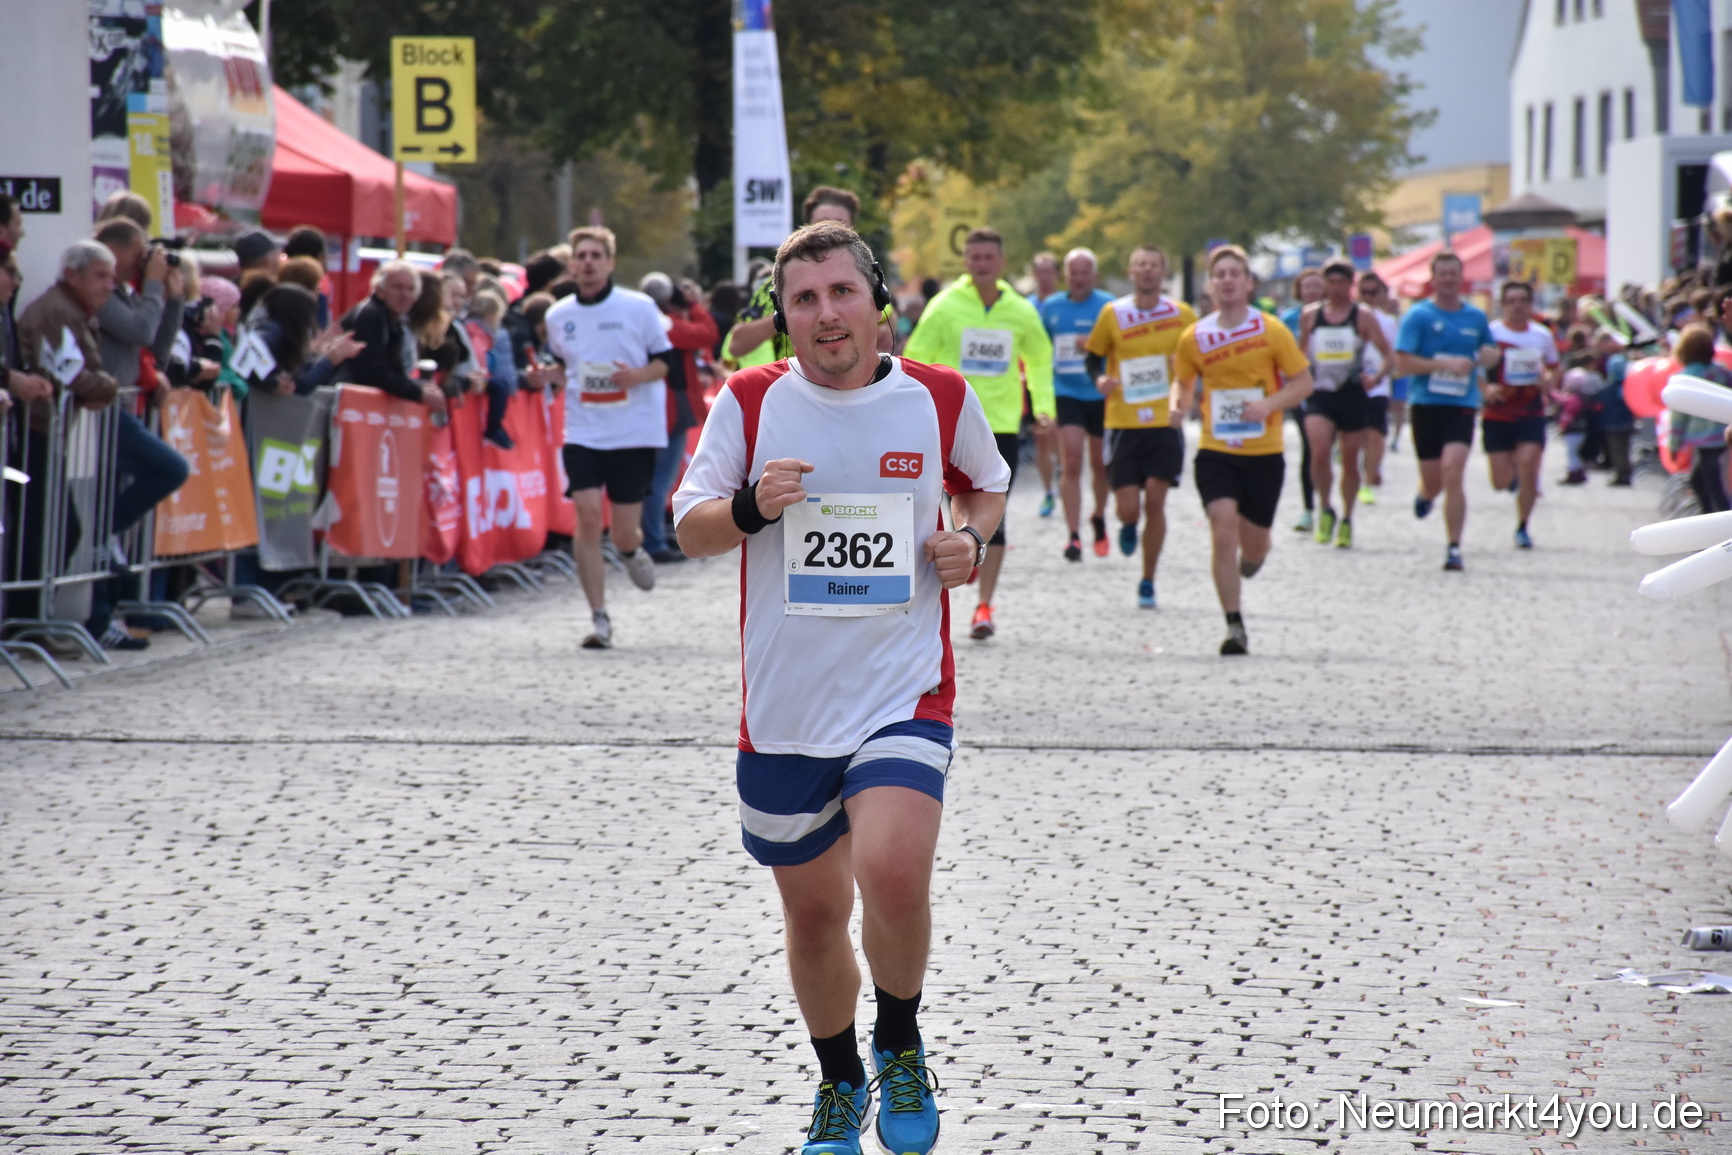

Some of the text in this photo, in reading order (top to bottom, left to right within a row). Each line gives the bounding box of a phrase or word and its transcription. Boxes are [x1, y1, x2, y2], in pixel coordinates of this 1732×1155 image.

[401, 43, 465, 66] Block
[415, 77, 455, 134] B
[1553, 252, 1568, 277] D
[885, 457, 919, 473] CSC
[834, 506, 878, 516] BOCK
[803, 531, 894, 569] 2362
[827, 582, 870, 596] Rainer
